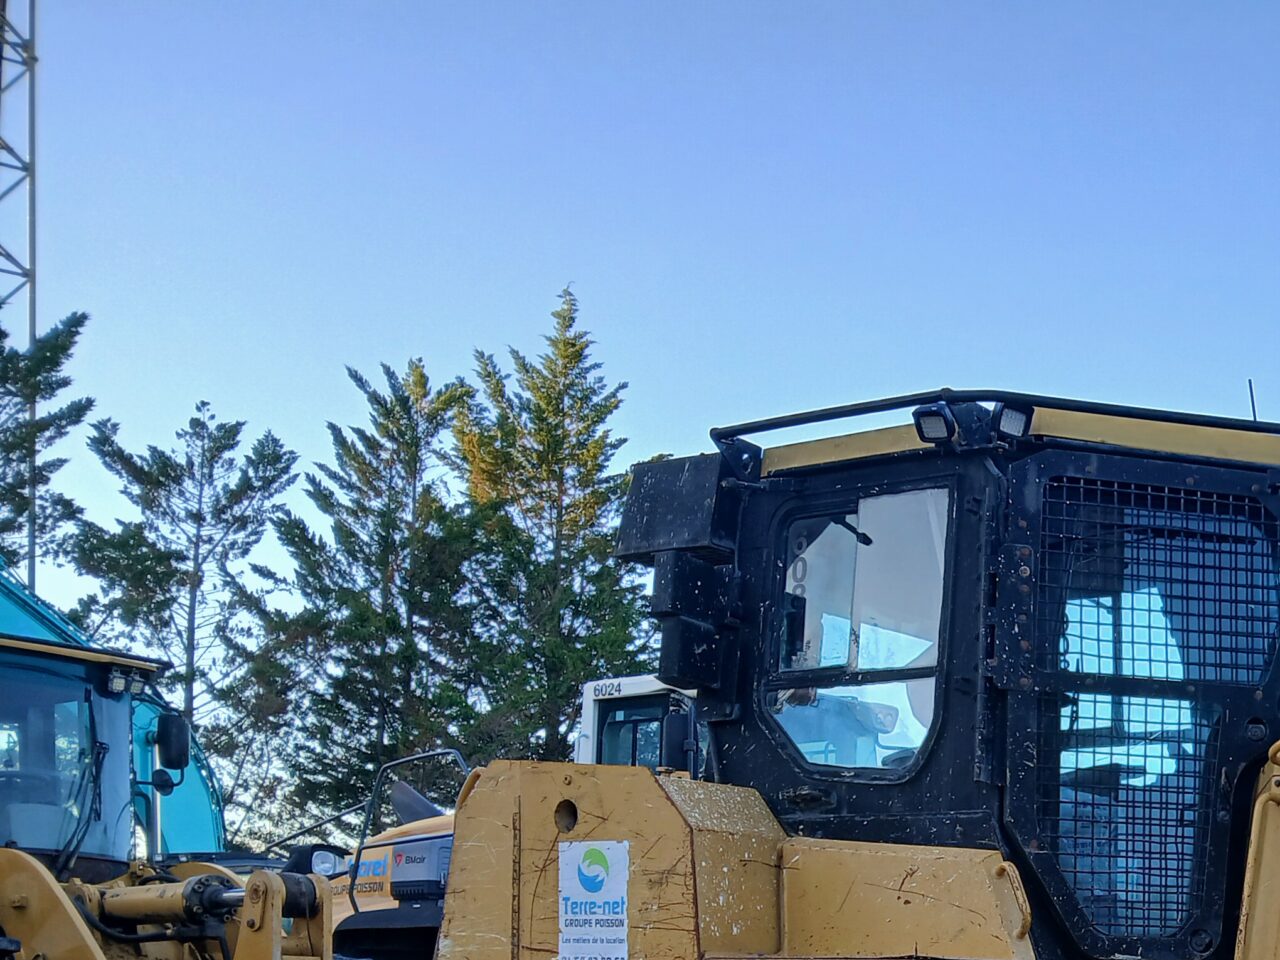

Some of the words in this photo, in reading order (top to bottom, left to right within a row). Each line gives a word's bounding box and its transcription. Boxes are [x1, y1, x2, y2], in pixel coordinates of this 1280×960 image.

[593, 682, 622, 697] 6024
[562, 895, 626, 915] Terre-net
[564, 918, 593, 928] GROUPE
[594, 918, 625, 928] POISSON
[606, 935, 626, 944] location
